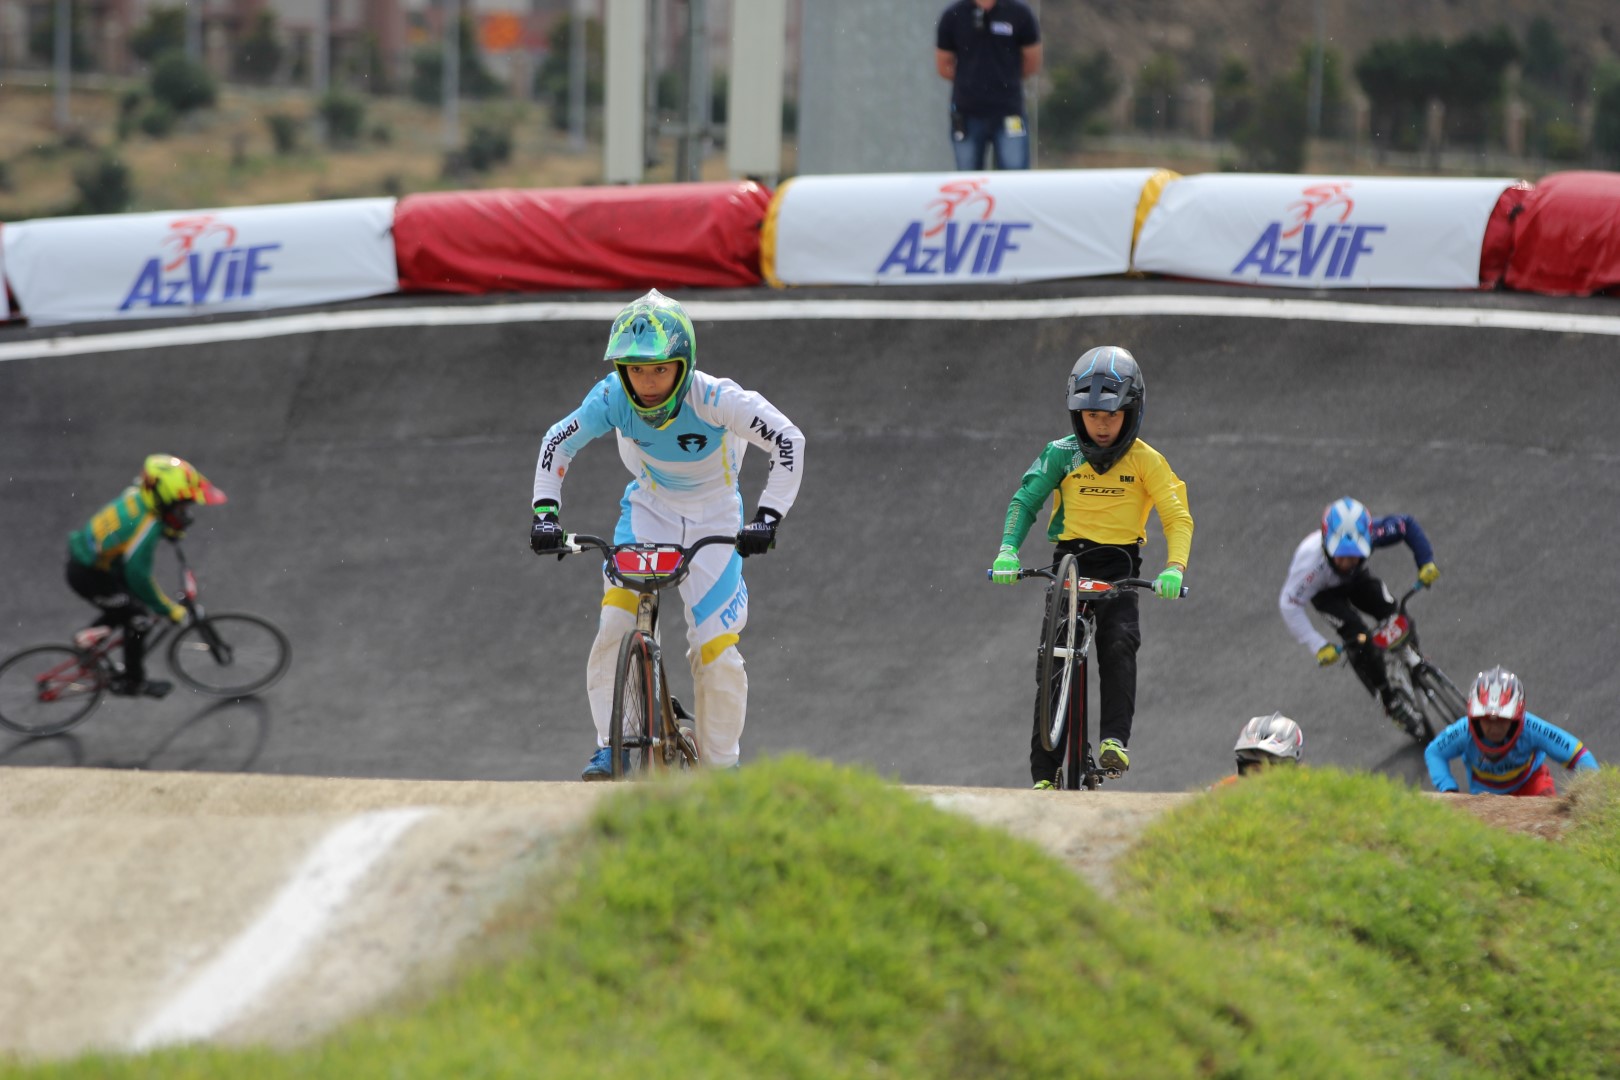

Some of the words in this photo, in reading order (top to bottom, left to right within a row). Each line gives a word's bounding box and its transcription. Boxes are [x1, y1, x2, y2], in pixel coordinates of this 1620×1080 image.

[876, 221, 1034, 275] AzViF
[1231, 222, 1388, 280] AzViF
[1119, 475, 1135, 483] BMX
[636, 552, 659, 571] 11
[1525, 719, 1571, 752] COLOMBIA
